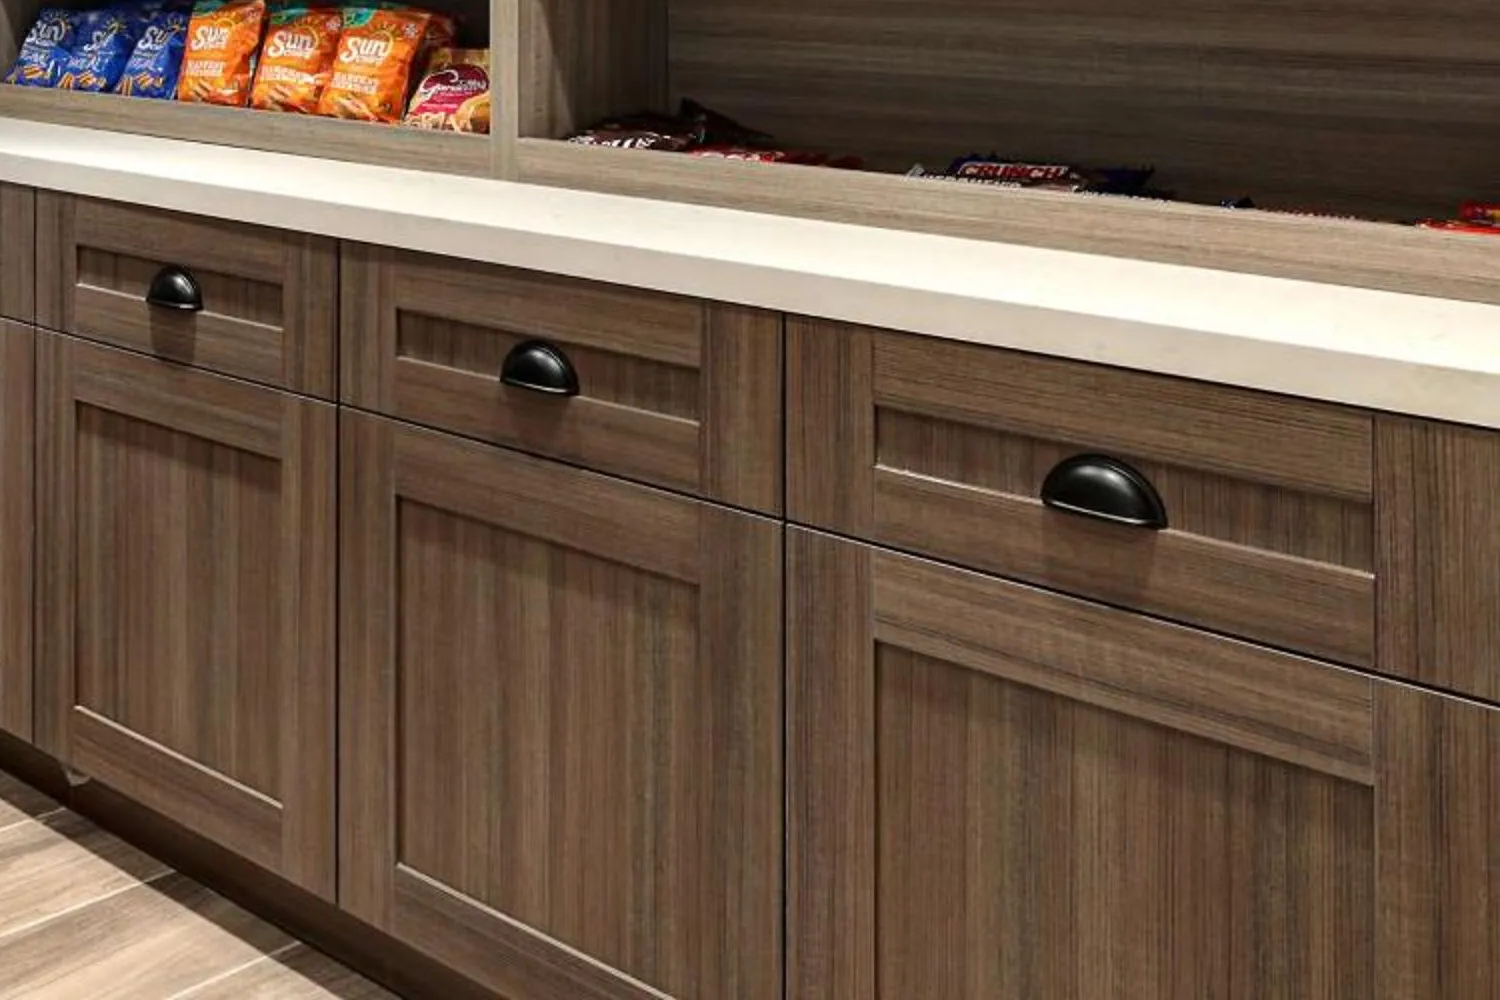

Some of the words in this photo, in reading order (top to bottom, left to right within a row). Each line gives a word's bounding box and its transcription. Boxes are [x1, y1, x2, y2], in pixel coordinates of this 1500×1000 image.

[137, 25, 168, 50] Su
[267, 30, 312, 57] Sun
[340, 36, 388, 63] Sun
[964, 163, 1062, 180] CRUNCH
